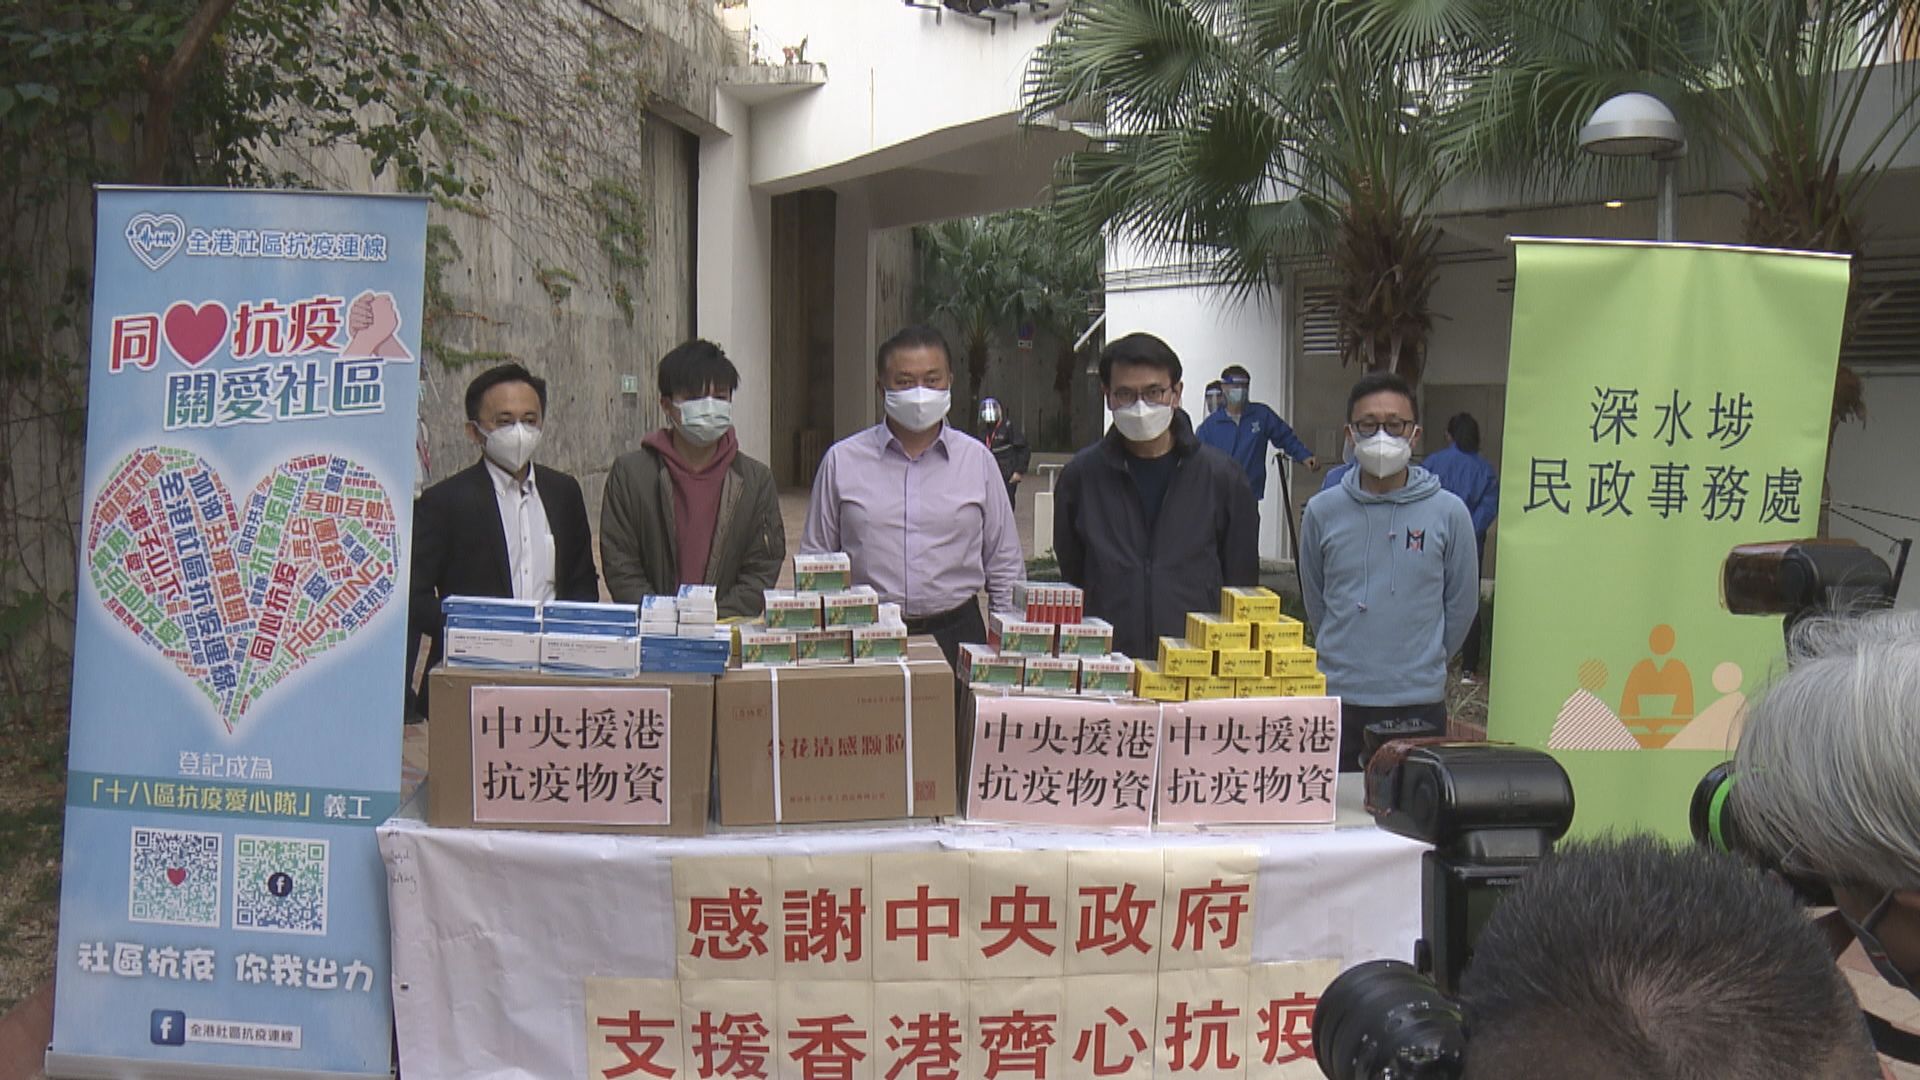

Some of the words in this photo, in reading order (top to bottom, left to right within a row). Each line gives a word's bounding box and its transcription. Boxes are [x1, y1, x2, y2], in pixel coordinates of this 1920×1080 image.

[186, 229, 386, 260] 全港社區抗疫連線
[233, 297, 342, 359] 抗疫
[165, 358, 383, 429] 關愛社區
[1589, 385, 1753, 450] 深水埗
[189, 470, 224, 521] 加油
[1523, 456, 1802, 524] 民政事務處
[127, 504, 182, 600] 獅子山下
[205, 524, 250, 623] 共渡難關
[159, 472, 238, 693] 全港社區抗疫連線
[285, 556, 384, 659] FIGHTING
[341, 576, 394, 631] 全民抗疫
[250, 561, 298, 662] 同心抗疫
[482, 706, 665, 749] 中央援港
[984, 712, 1156, 759] 中央援港
[1169, 715, 1336, 757] 中央援港
[178, 751, 273, 780] 登記成為
[482, 761, 665, 805] 抗疫物資
[977, 763, 1151, 811] 抗疫物資
[1167, 764, 1335, 805] 抗疫物資
[91, 777, 311, 817] 「十八區抗疫愛心隊」
[324, 794, 371, 819] 義工
[688, 878, 1250, 963] 感謝中央政府
[78, 942, 215, 981] 社區抗疫
[235, 952, 374, 992] 你我出力
[190, 1023, 294, 1043] 全港社區抗疫連線
[596, 991, 1319, 1080] 支援香港齊心抗疫
